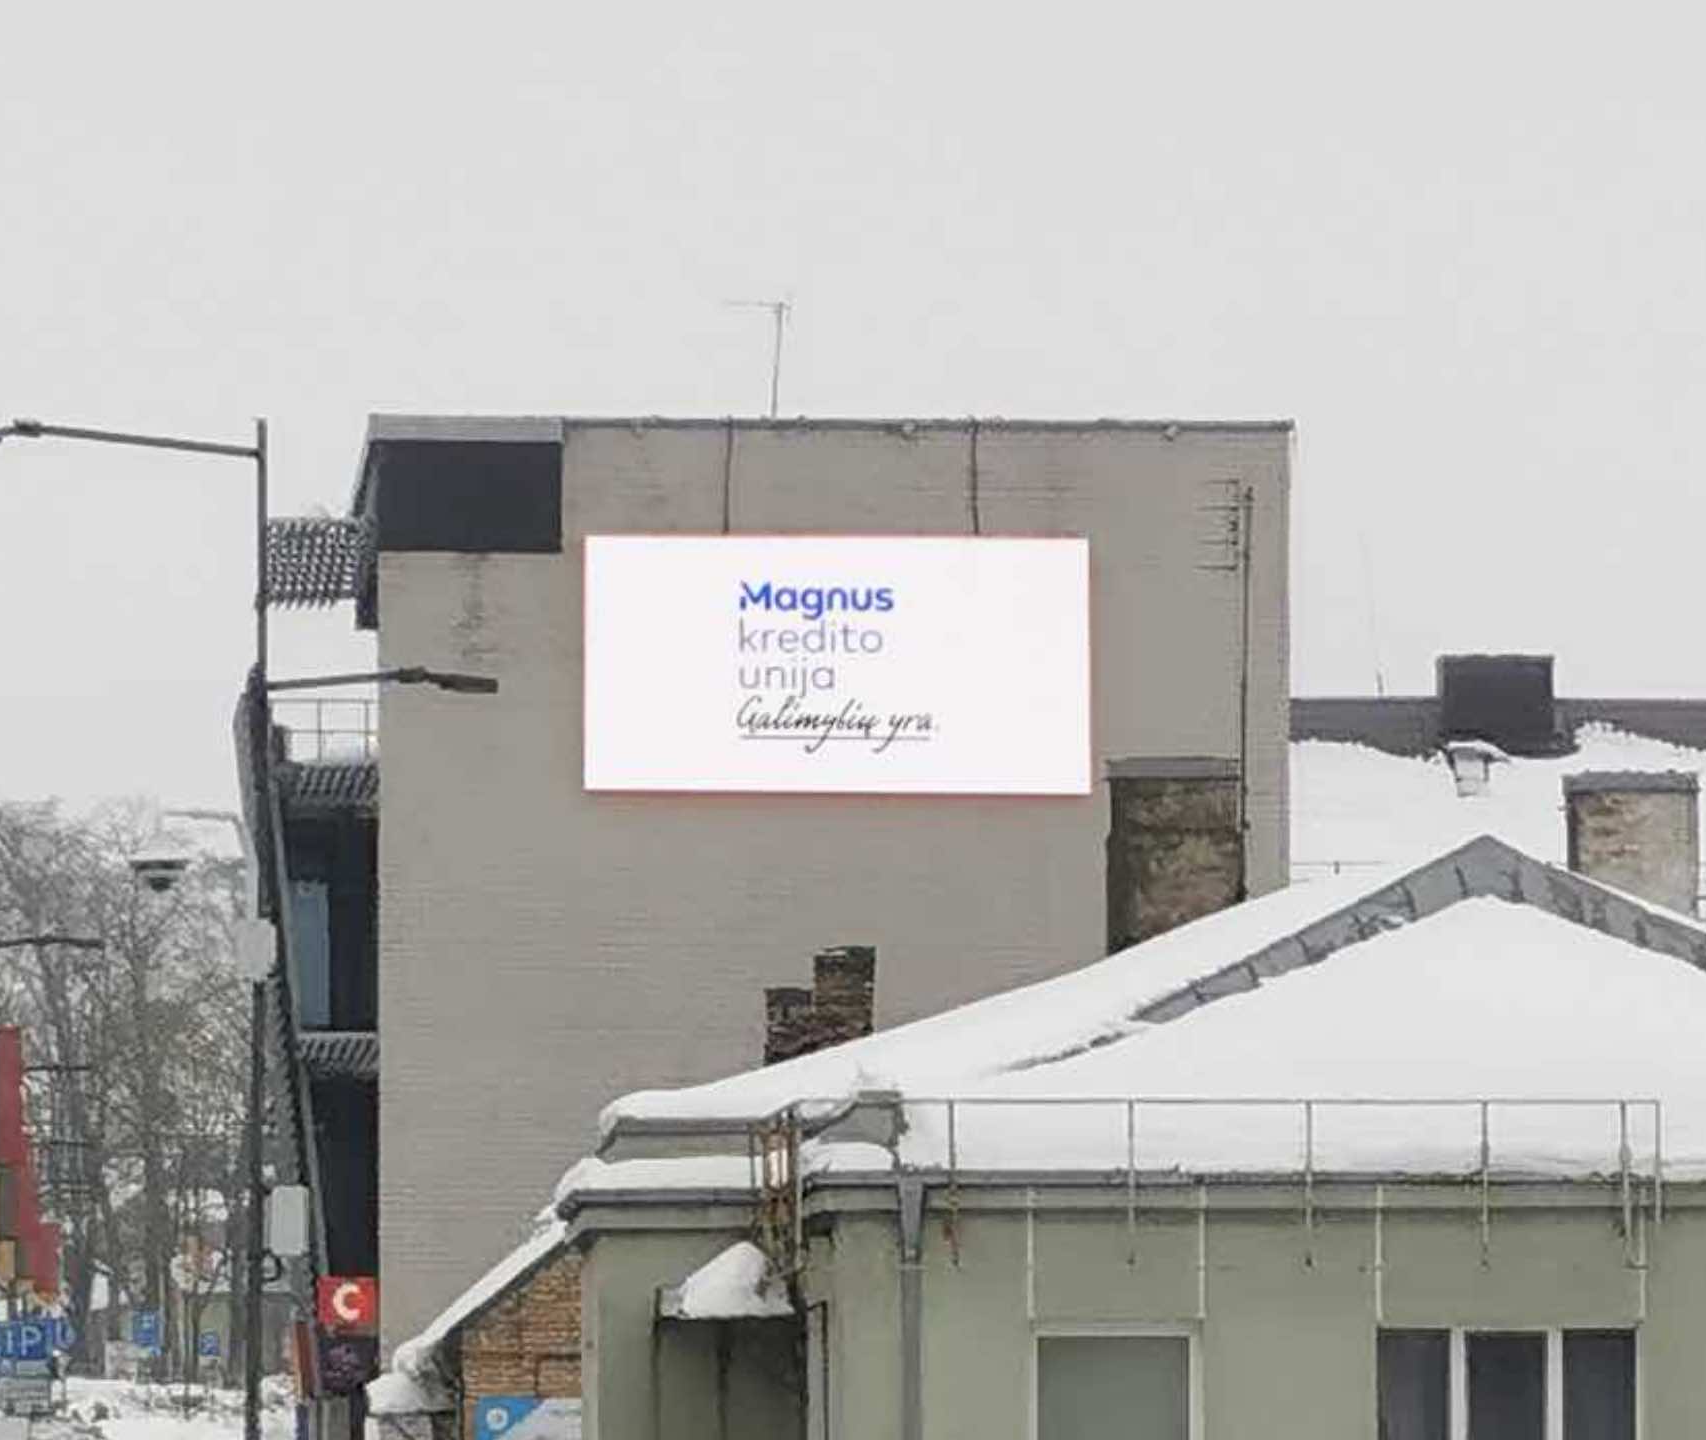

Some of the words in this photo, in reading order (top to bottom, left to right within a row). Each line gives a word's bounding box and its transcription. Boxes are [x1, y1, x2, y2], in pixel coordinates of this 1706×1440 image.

[739, 579, 895, 621] Magnus
[738, 616, 884, 654] kredito
[738, 655, 836, 699] unija
